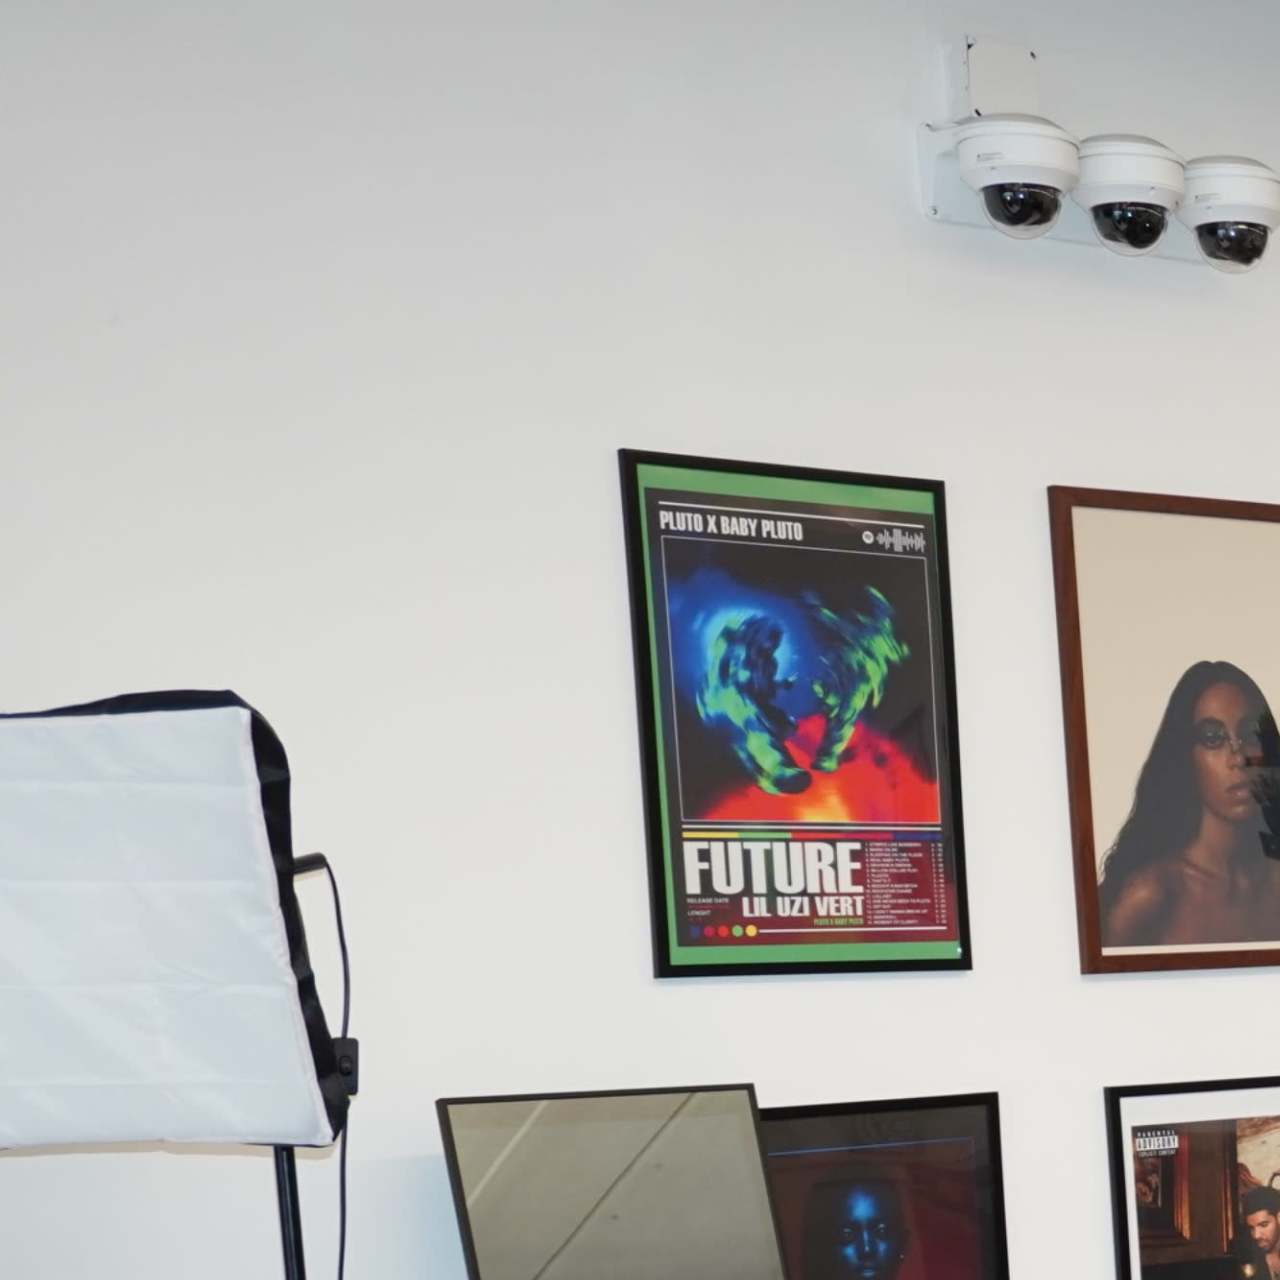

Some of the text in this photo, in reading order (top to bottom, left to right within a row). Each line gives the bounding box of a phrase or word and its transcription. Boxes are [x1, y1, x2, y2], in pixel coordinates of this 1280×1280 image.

[659, 510, 803, 541] PLUTO X BABY PLUTO
[682, 841, 864, 895] FUTURE
[742, 895, 865, 917] LIL UZI VERT
[1135, 1136, 1178, 1150] ADVISORY
